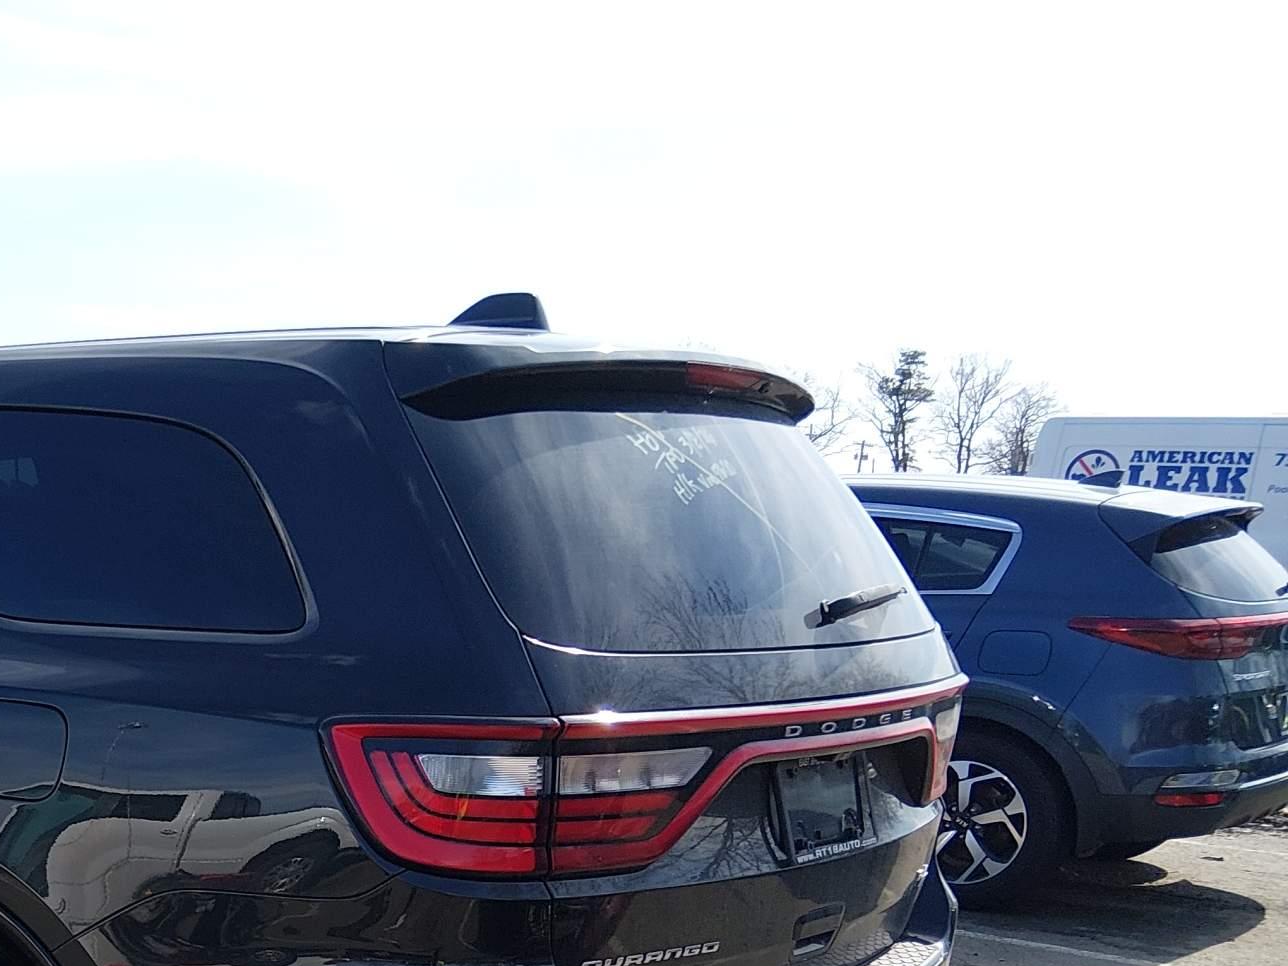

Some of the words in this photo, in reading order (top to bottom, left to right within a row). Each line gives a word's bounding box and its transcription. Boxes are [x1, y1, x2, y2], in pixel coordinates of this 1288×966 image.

[1129, 450, 1254, 465] AMERICAN
[1127, 465, 1249, 494] LEAK
[784, 709, 913, 738] DODGE
